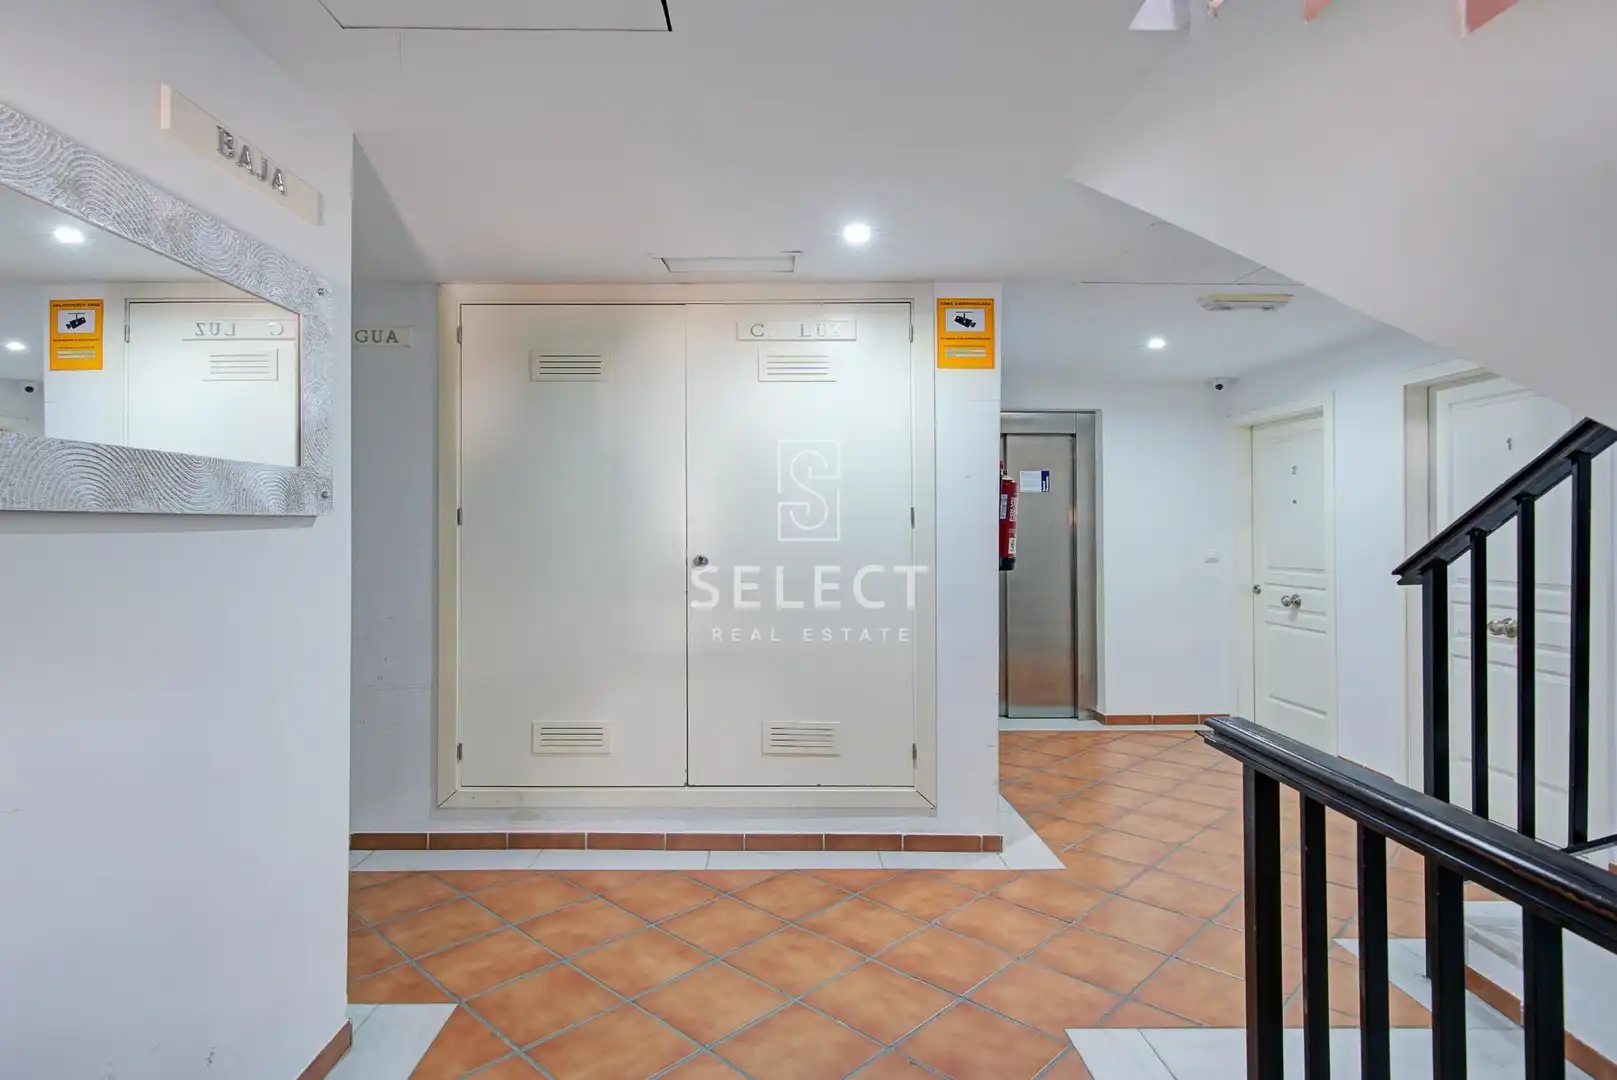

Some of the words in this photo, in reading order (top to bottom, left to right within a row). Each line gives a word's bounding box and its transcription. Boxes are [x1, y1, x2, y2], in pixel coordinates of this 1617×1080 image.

[216, 124, 288, 196] BAJA
[351, 329, 399, 343] GUA
[798, 322, 841, 337] LUZ
[1506, 437, 1513, 450] 1
[1291, 465, 1298, 475] 2
